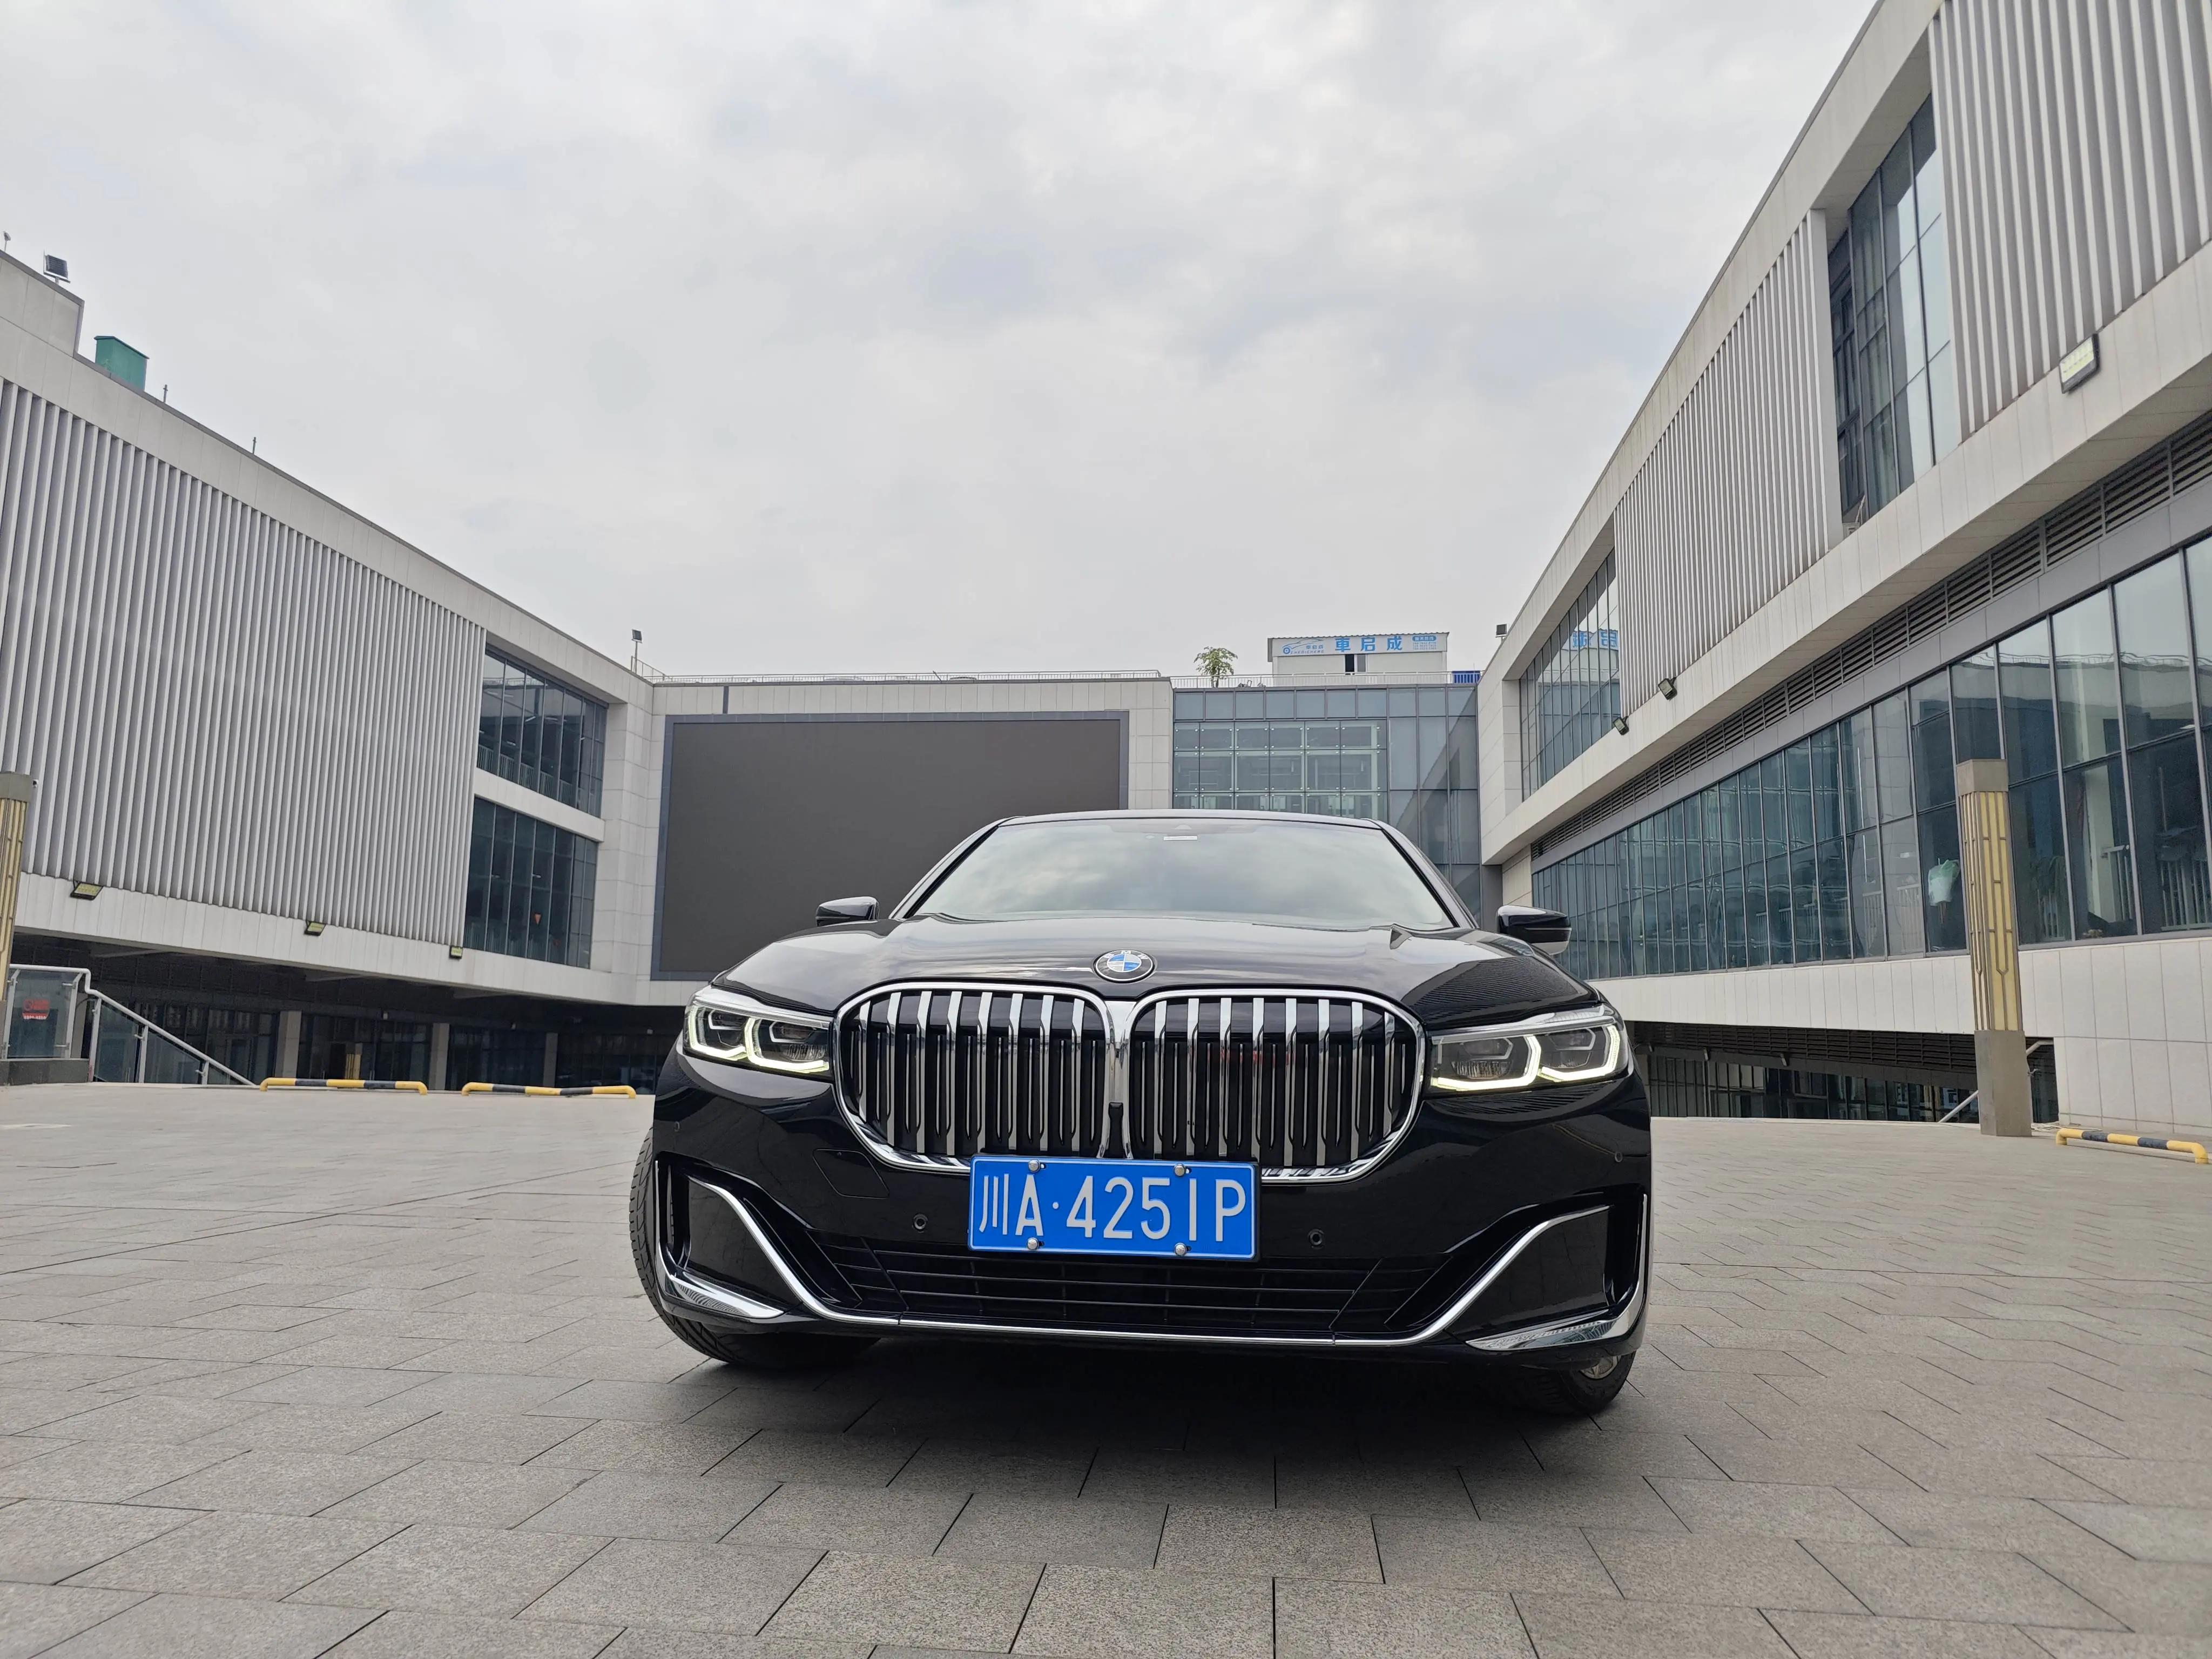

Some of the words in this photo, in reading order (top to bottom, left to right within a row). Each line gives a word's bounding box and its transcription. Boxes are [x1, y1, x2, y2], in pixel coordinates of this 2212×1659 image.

[1334, 635, 1403, 652] 車启成
[1103, 950, 1149, 960] BMW
